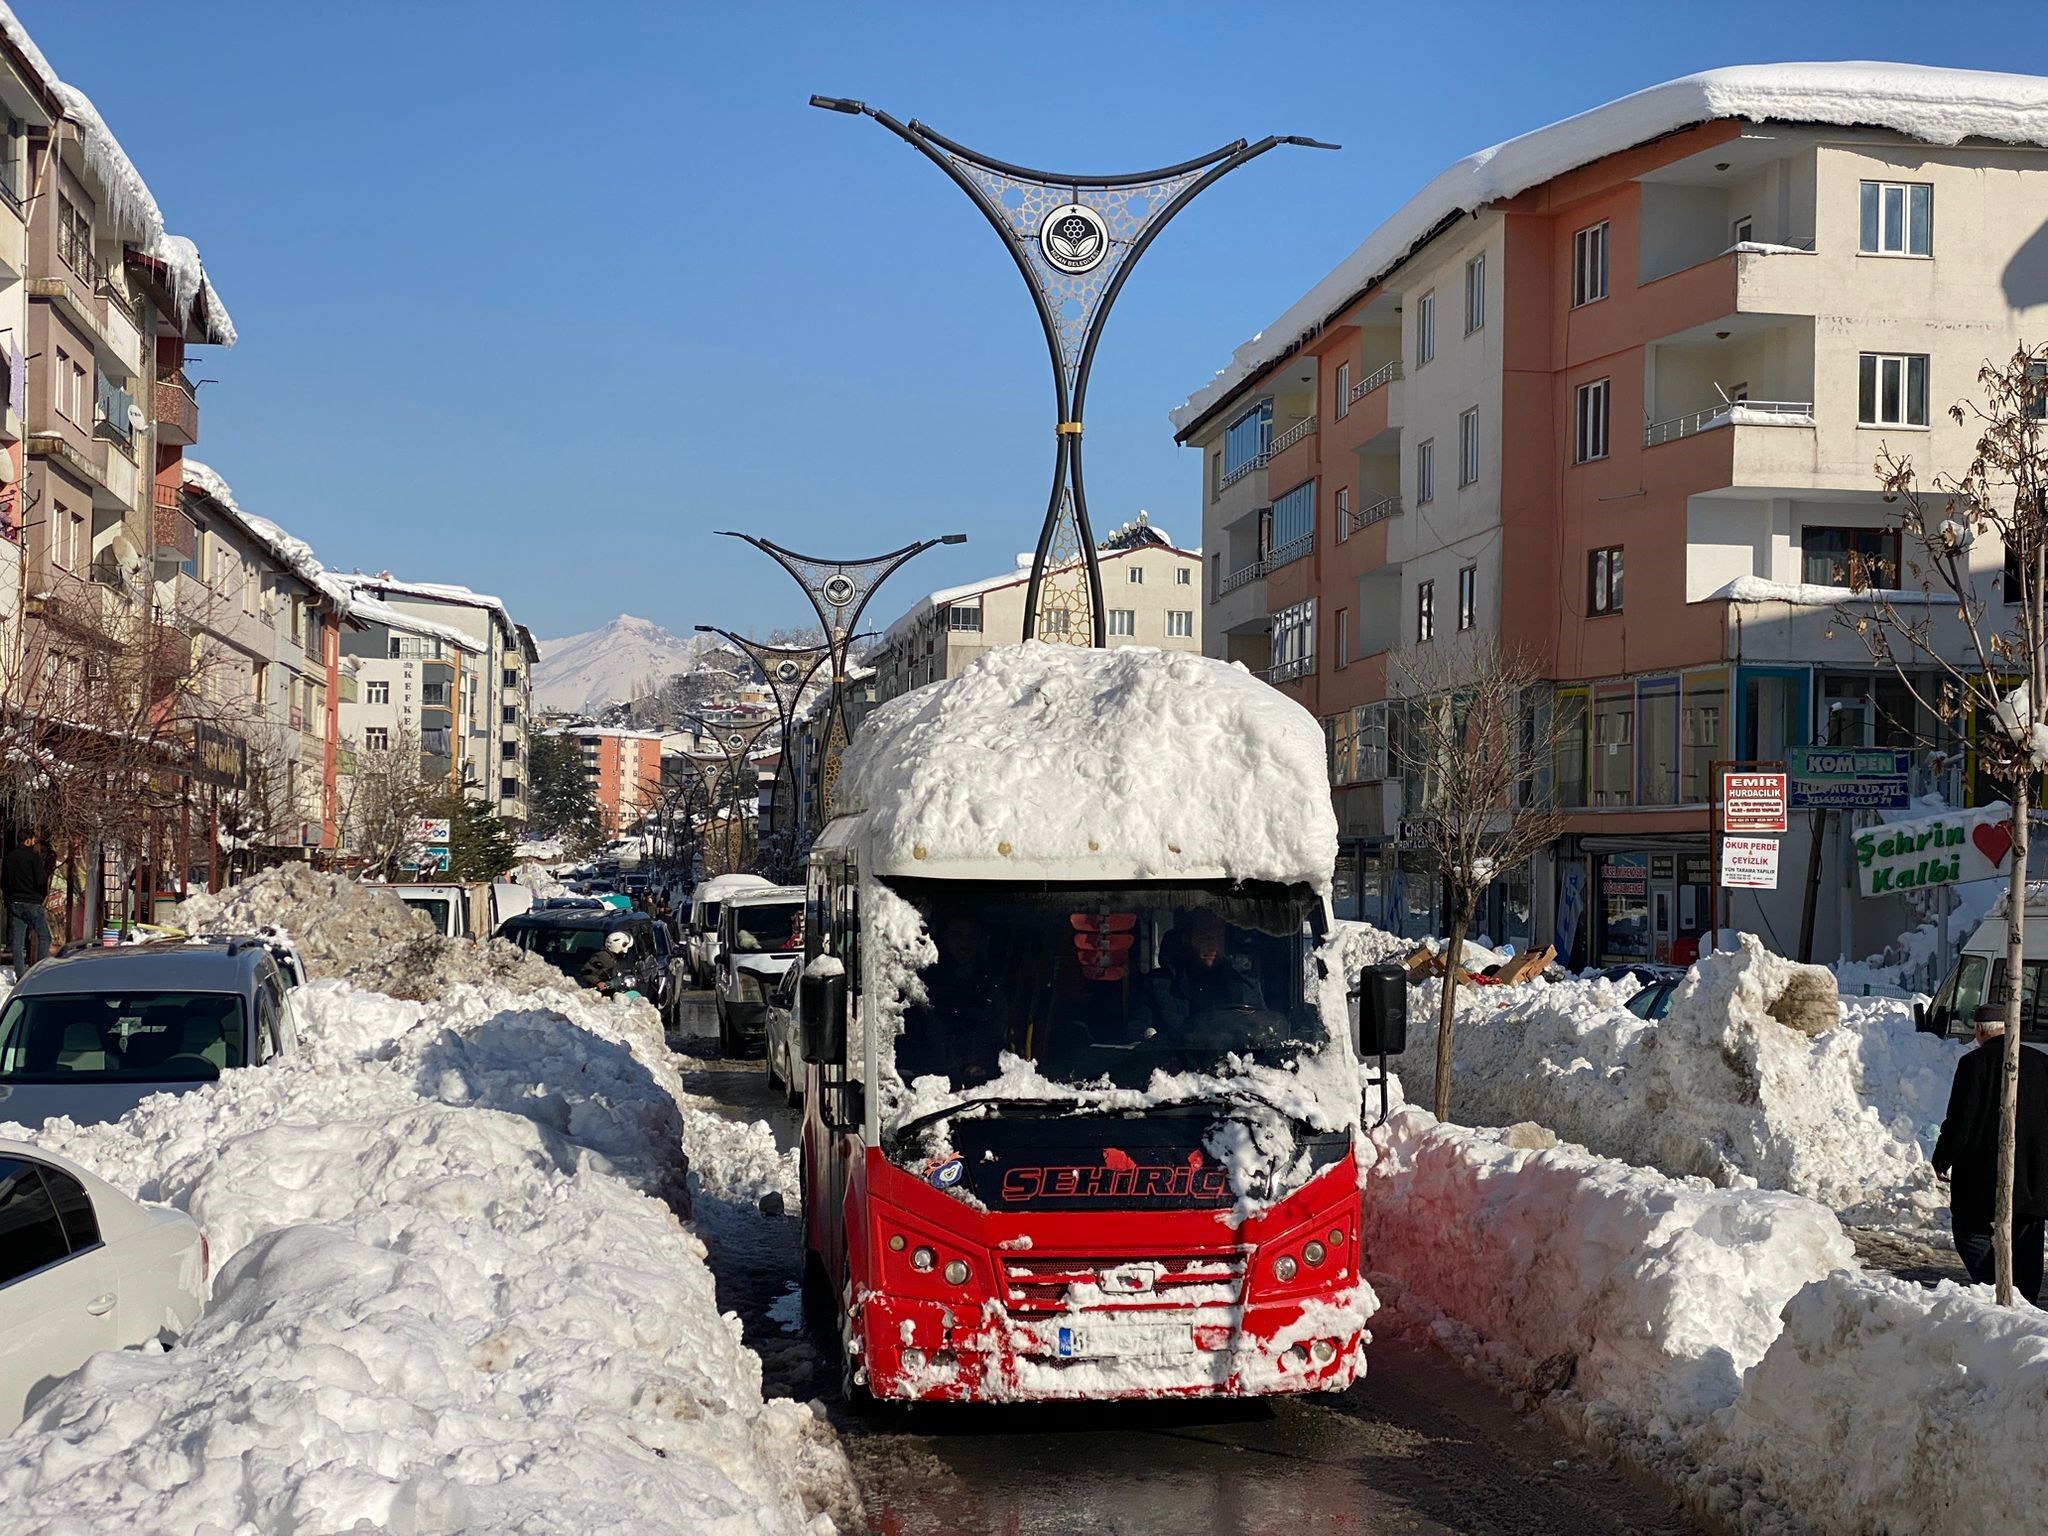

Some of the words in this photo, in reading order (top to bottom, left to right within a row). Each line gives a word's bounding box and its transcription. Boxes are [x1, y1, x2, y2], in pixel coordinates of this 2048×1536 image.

[1807, 756, 1893, 773] KOMPEN
[1731, 777, 1779, 787] EMİR
[1729, 789, 1781, 797] HURDACILIK
[1725, 841, 1749, 850] OKUR
[1750, 842, 1777, 851] PERDE
[1856, 822, 1965, 867] Şehrin
[1732, 856, 1768, 865] ÇEYİZLİK
[1871, 854, 1960, 893] Kalbi
